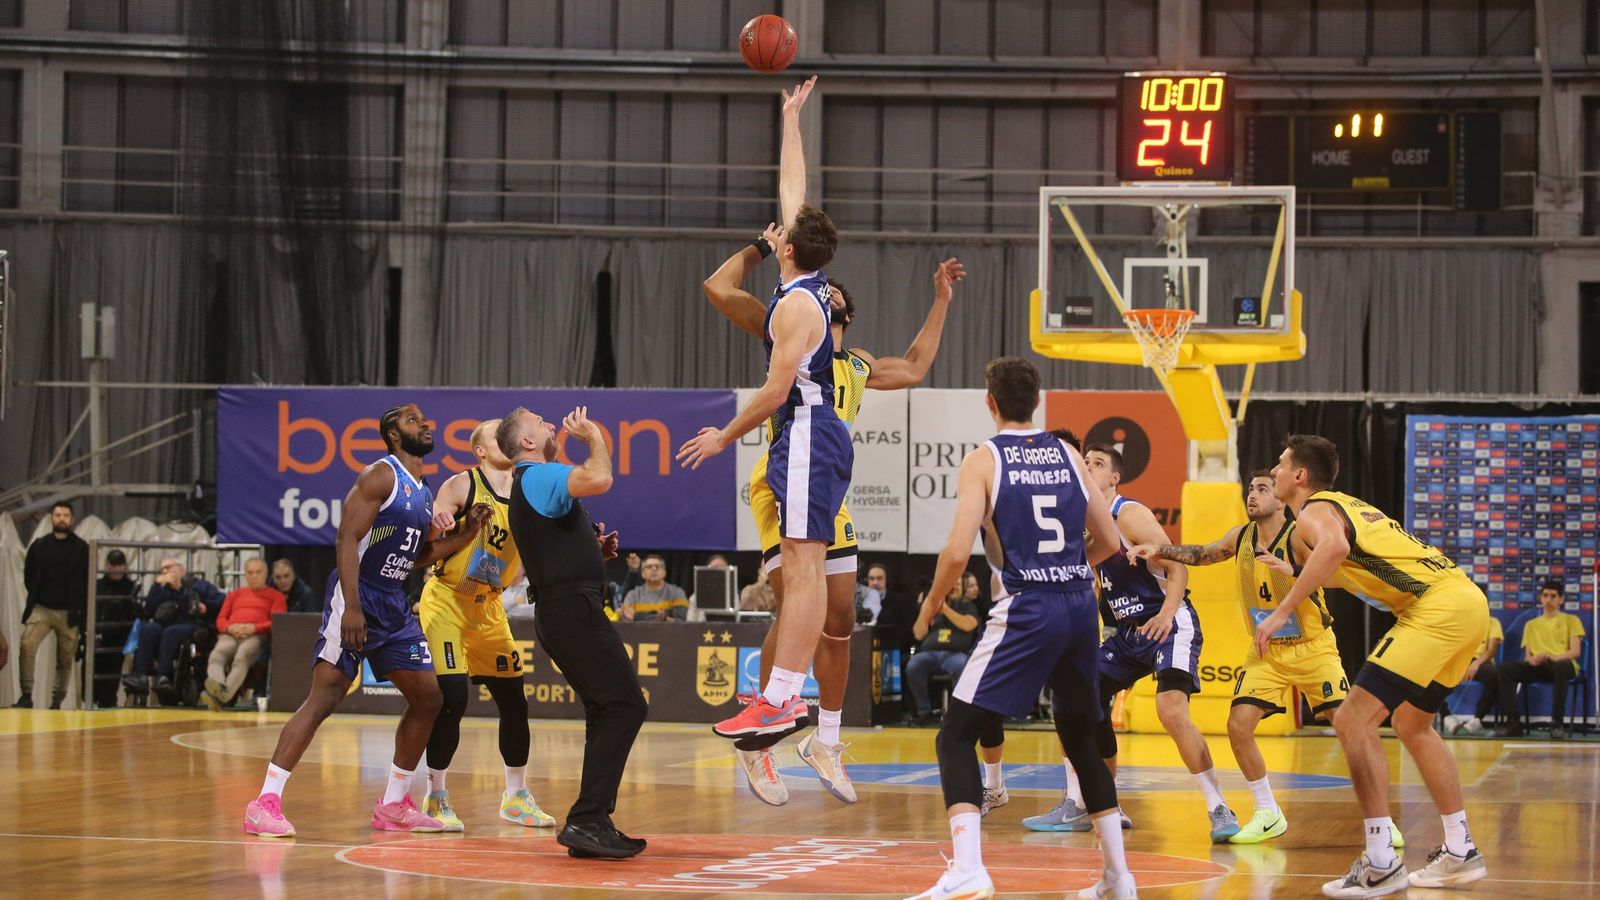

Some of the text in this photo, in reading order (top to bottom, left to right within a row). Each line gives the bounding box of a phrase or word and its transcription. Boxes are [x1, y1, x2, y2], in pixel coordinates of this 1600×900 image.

[1140, 78, 1224, 112] 10:00
[1137, 119, 1212, 167] 24
[1312, 149, 1430, 166] HOME GUEST
[1154, 167, 1194, 177] Quince
[1003, 446, 1064, 465] DE LARREA
[1008, 469, 1071, 485] PAMESA
[853, 486, 891, 494] GERSA
[853, 496, 901, 506] HYGIENE
[1032, 495, 1066, 553] 5
[488, 524, 509, 551] 22
[1100, 570, 1113, 592] 4
[1259, 581, 1272, 602] 4
